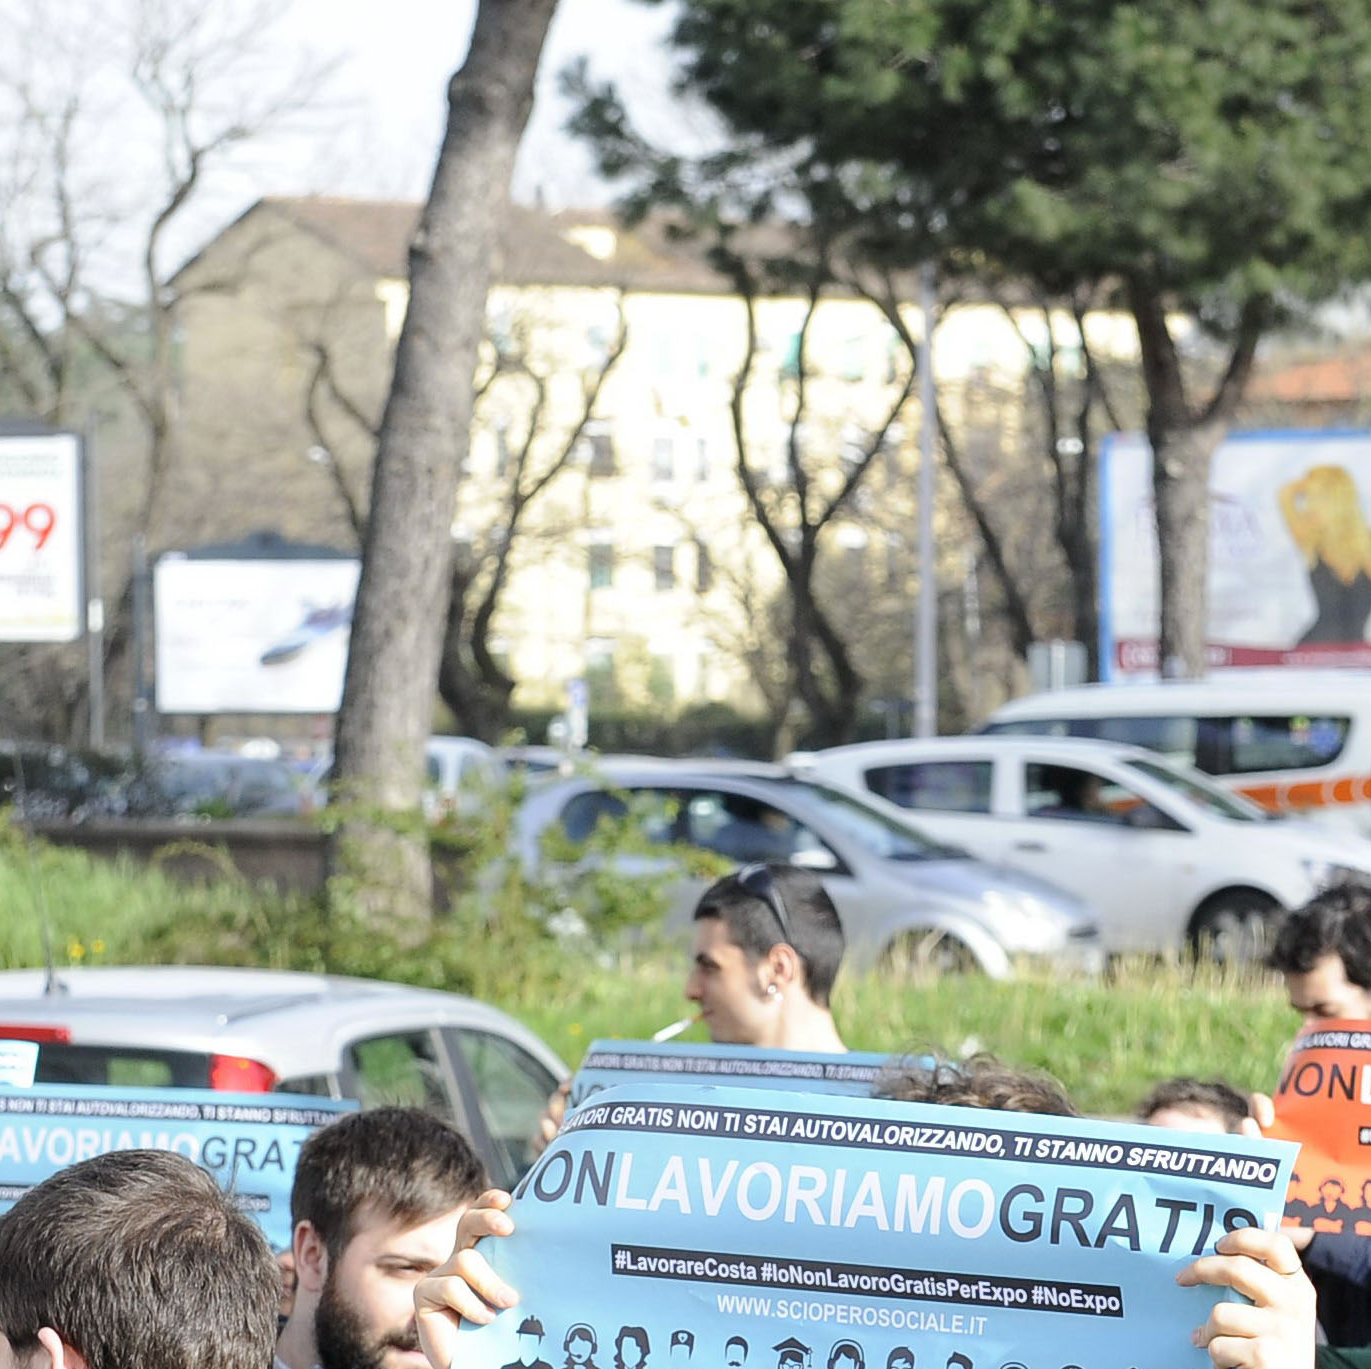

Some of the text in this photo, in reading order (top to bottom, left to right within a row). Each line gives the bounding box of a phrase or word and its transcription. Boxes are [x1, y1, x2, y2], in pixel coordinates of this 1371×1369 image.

[611, 1106, 673, 1127] GRATIS
[678, 1110, 718, 1131] NON
[723, 1112, 741, 1132] TI
[743, 1115, 787, 1136] STAI
[790, 1118, 1006, 1157] AUTOVALORIZZANDO,
[1013, 1137, 1031, 1157] TI
[1035, 1140, 1124, 1164] STANNO
[1127, 1148, 1277, 1184] SFRUTTANDO
[614, 1250, 1120, 1314] #LavorareCosta #IoNonLavoroGratisPerExpo #NoExpo
[717, 1294, 988, 1336] WWW.SCIOPEROSOCIALE.IT
